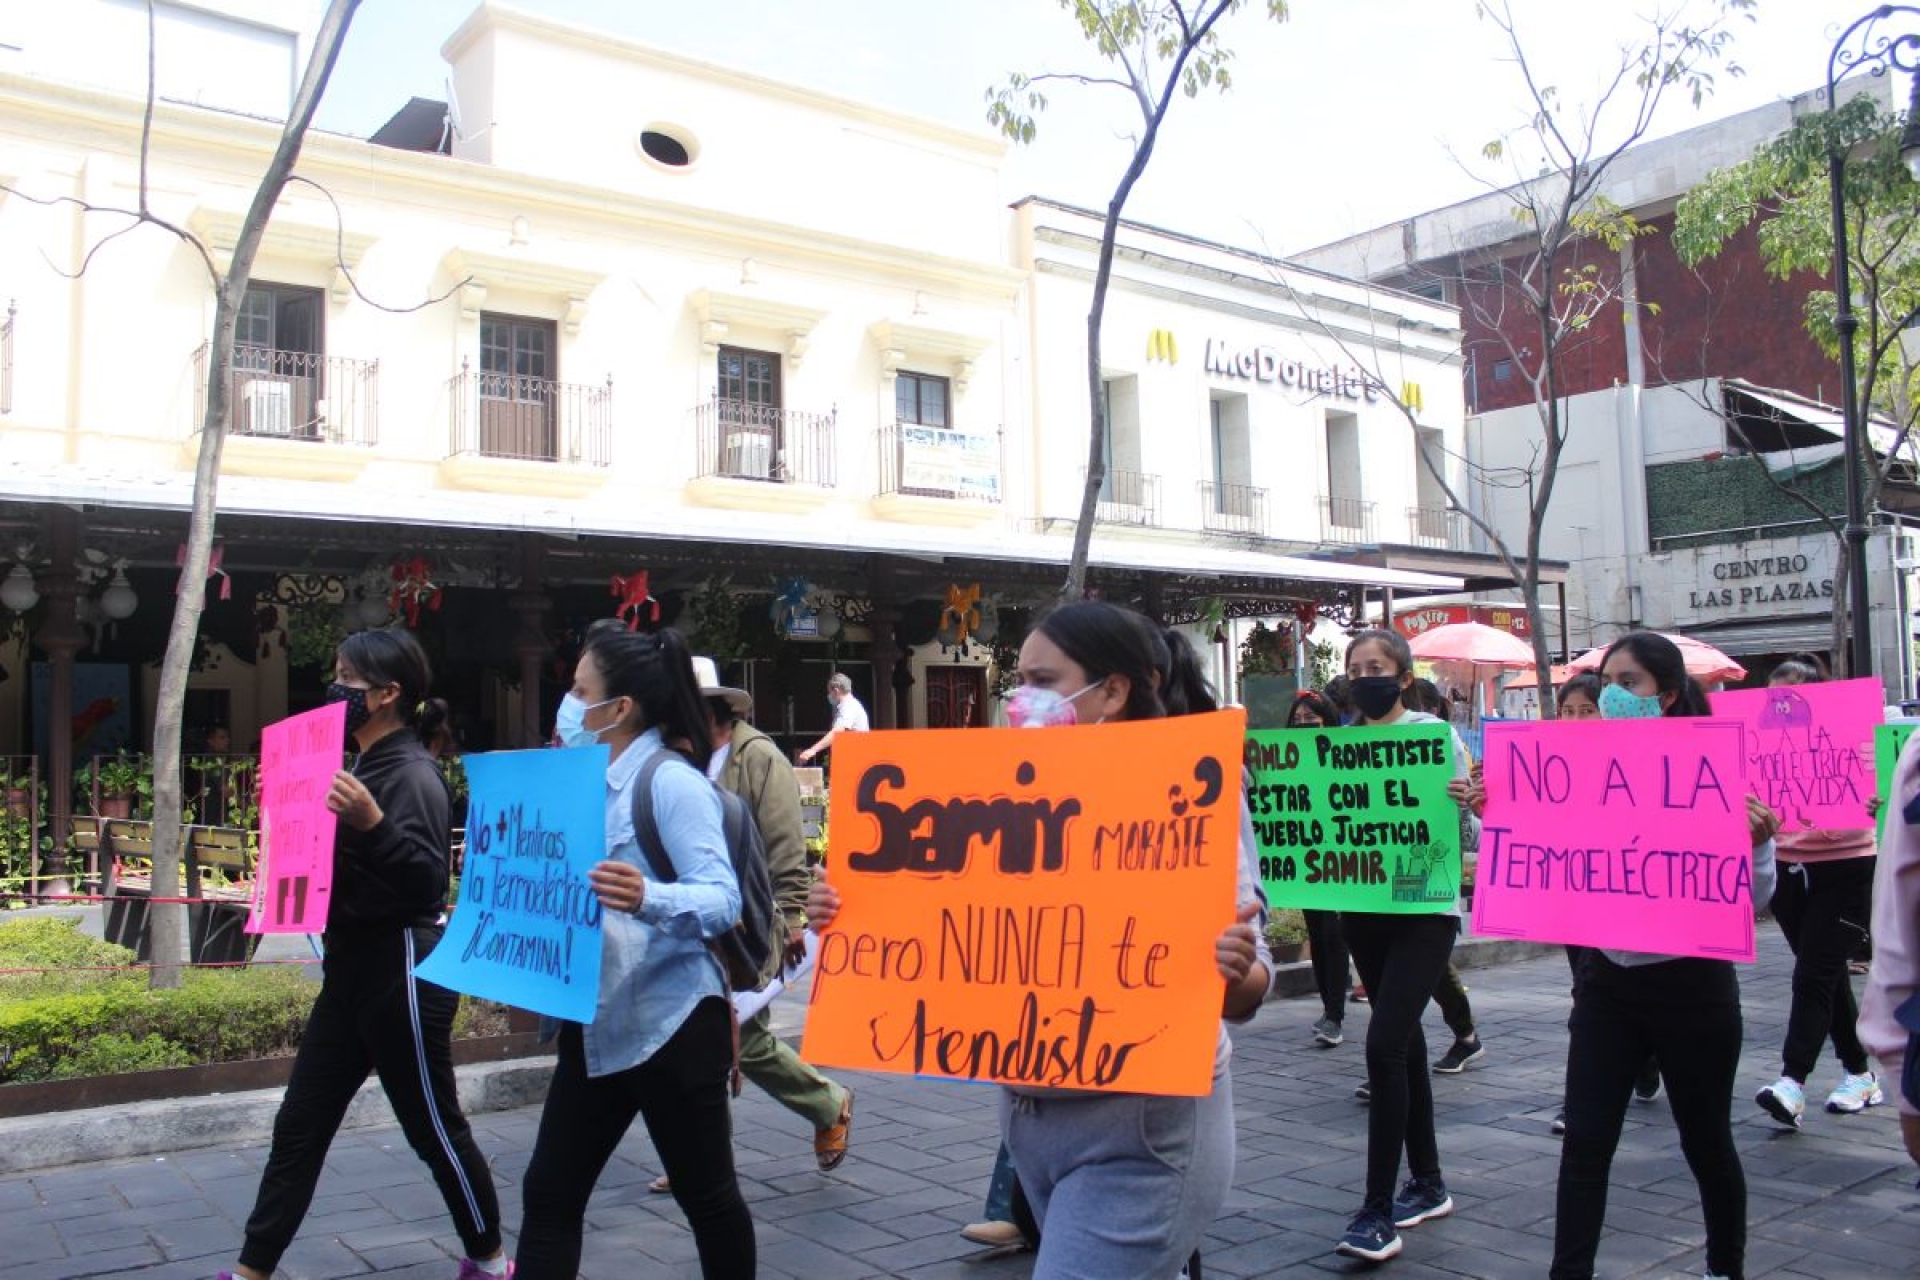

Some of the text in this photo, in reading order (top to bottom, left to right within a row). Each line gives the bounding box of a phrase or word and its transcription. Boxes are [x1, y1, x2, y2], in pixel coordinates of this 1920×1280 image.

[1713, 555, 1807, 580] CENTRO
[1689, 578, 1833, 609] LAS PLAZAS
[1315, 734, 1446, 770] PROMETISTE
[1508, 741, 1732, 813] NO A LA
[1795, 776, 1860, 806] VIDA
[1248, 779, 1420, 814] ESTAR CON EL
[470, 803, 492, 856] No
[509, 803, 566, 863] Mentiras
[846, 761, 1082, 880] Samir
[1331, 815, 1430, 846] JUSTICIA
[467, 858, 484, 904] la
[1260, 849, 1388, 885] ARA SAMIR
[1483, 826, 1753, 905] TERMOELÉCTRICA
[809, 903, 1171, 1006] pero NUNCA te
